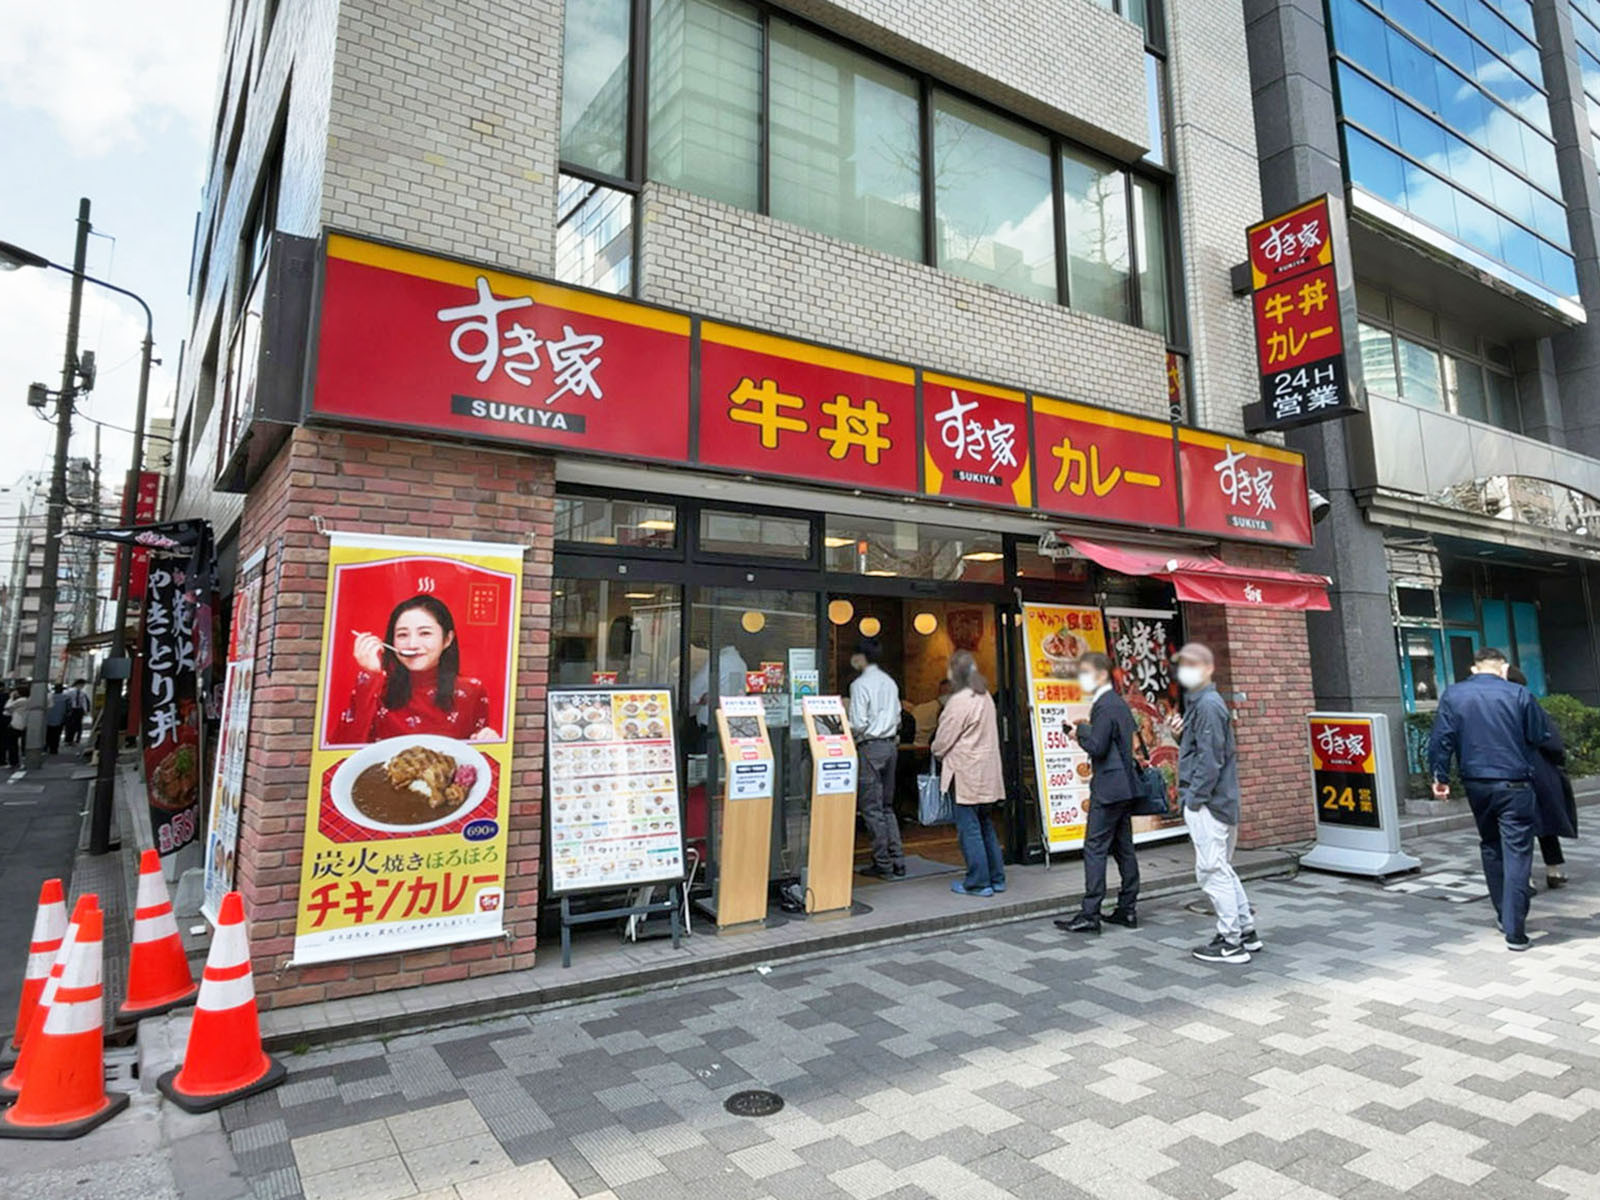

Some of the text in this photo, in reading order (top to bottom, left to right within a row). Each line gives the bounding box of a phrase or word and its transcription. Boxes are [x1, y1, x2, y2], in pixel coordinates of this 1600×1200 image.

[1260, 220, 1322, 263] すき家
[1264, 278, 1330, 324] 牛丼
[437, 275, 604, 405] すき家
[1266, 325, 1334, 364] カレー
[1272, 384, 1340, 419] 営業
[1274, 364, 1335, 395] 24H
[471, 400, 569, 430] SUKIYA
[729, 377, 893, 465] 牛丼
[934, 389, 1018, 473] すき家
[958, 470, 997, 486] SUKIYA
[1051, 437, 1162, 497] カレー
[1214, 443, 1277, 516] すき家
[1231, 514, 1268, 531] SUKIYA
[147, 567, 182, 749] やきとり丼
[1152, 621, 1171, 690] 香ばしい
[1317, 725, 1366, 759] すき家
[1322, 785, 1356, 812] 24
[306, 871, 499, 928] チキンカレー
